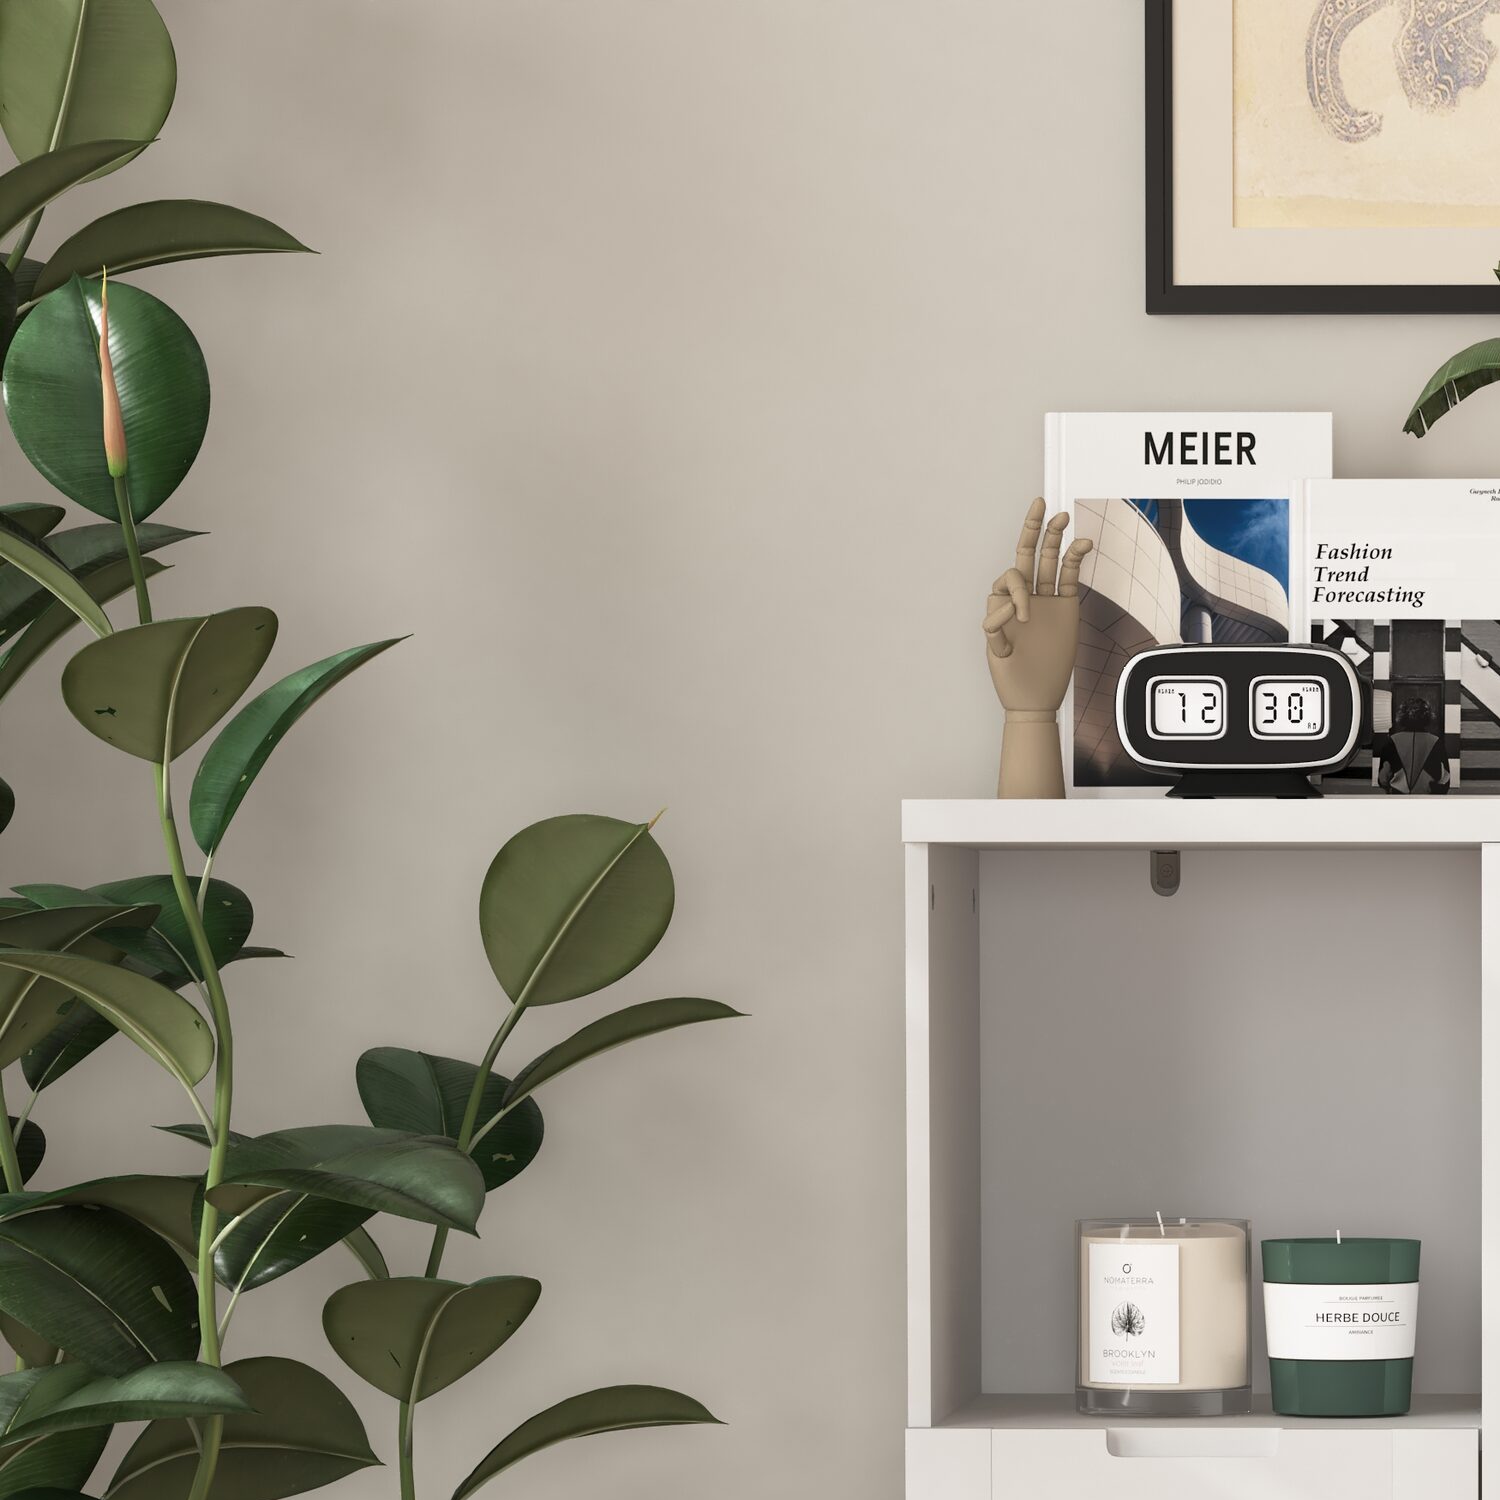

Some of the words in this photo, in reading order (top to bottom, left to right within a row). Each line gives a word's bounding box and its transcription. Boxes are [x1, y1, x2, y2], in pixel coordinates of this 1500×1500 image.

[1144, 431, 1257, 465] MEIER
[1197, 478, 1222, 486] JODIDIO
[1315, 543, 1393, 560] Fashion
[1313, 566, 1370, 582] Trend
[1312, 586, 1426, 608] Forecasting
[1178, 692, 1216, 723] 12
[1262, 692, 1303, 724] 30
[1104, 1277, 1154, 1285] NOMATERRA
[1316, 1312, 1360, 1323] HERBE
[1362, 1311, 1400, 1323] DOUCE
[1103, 1349, 1156, 1358] BROOKLYN
